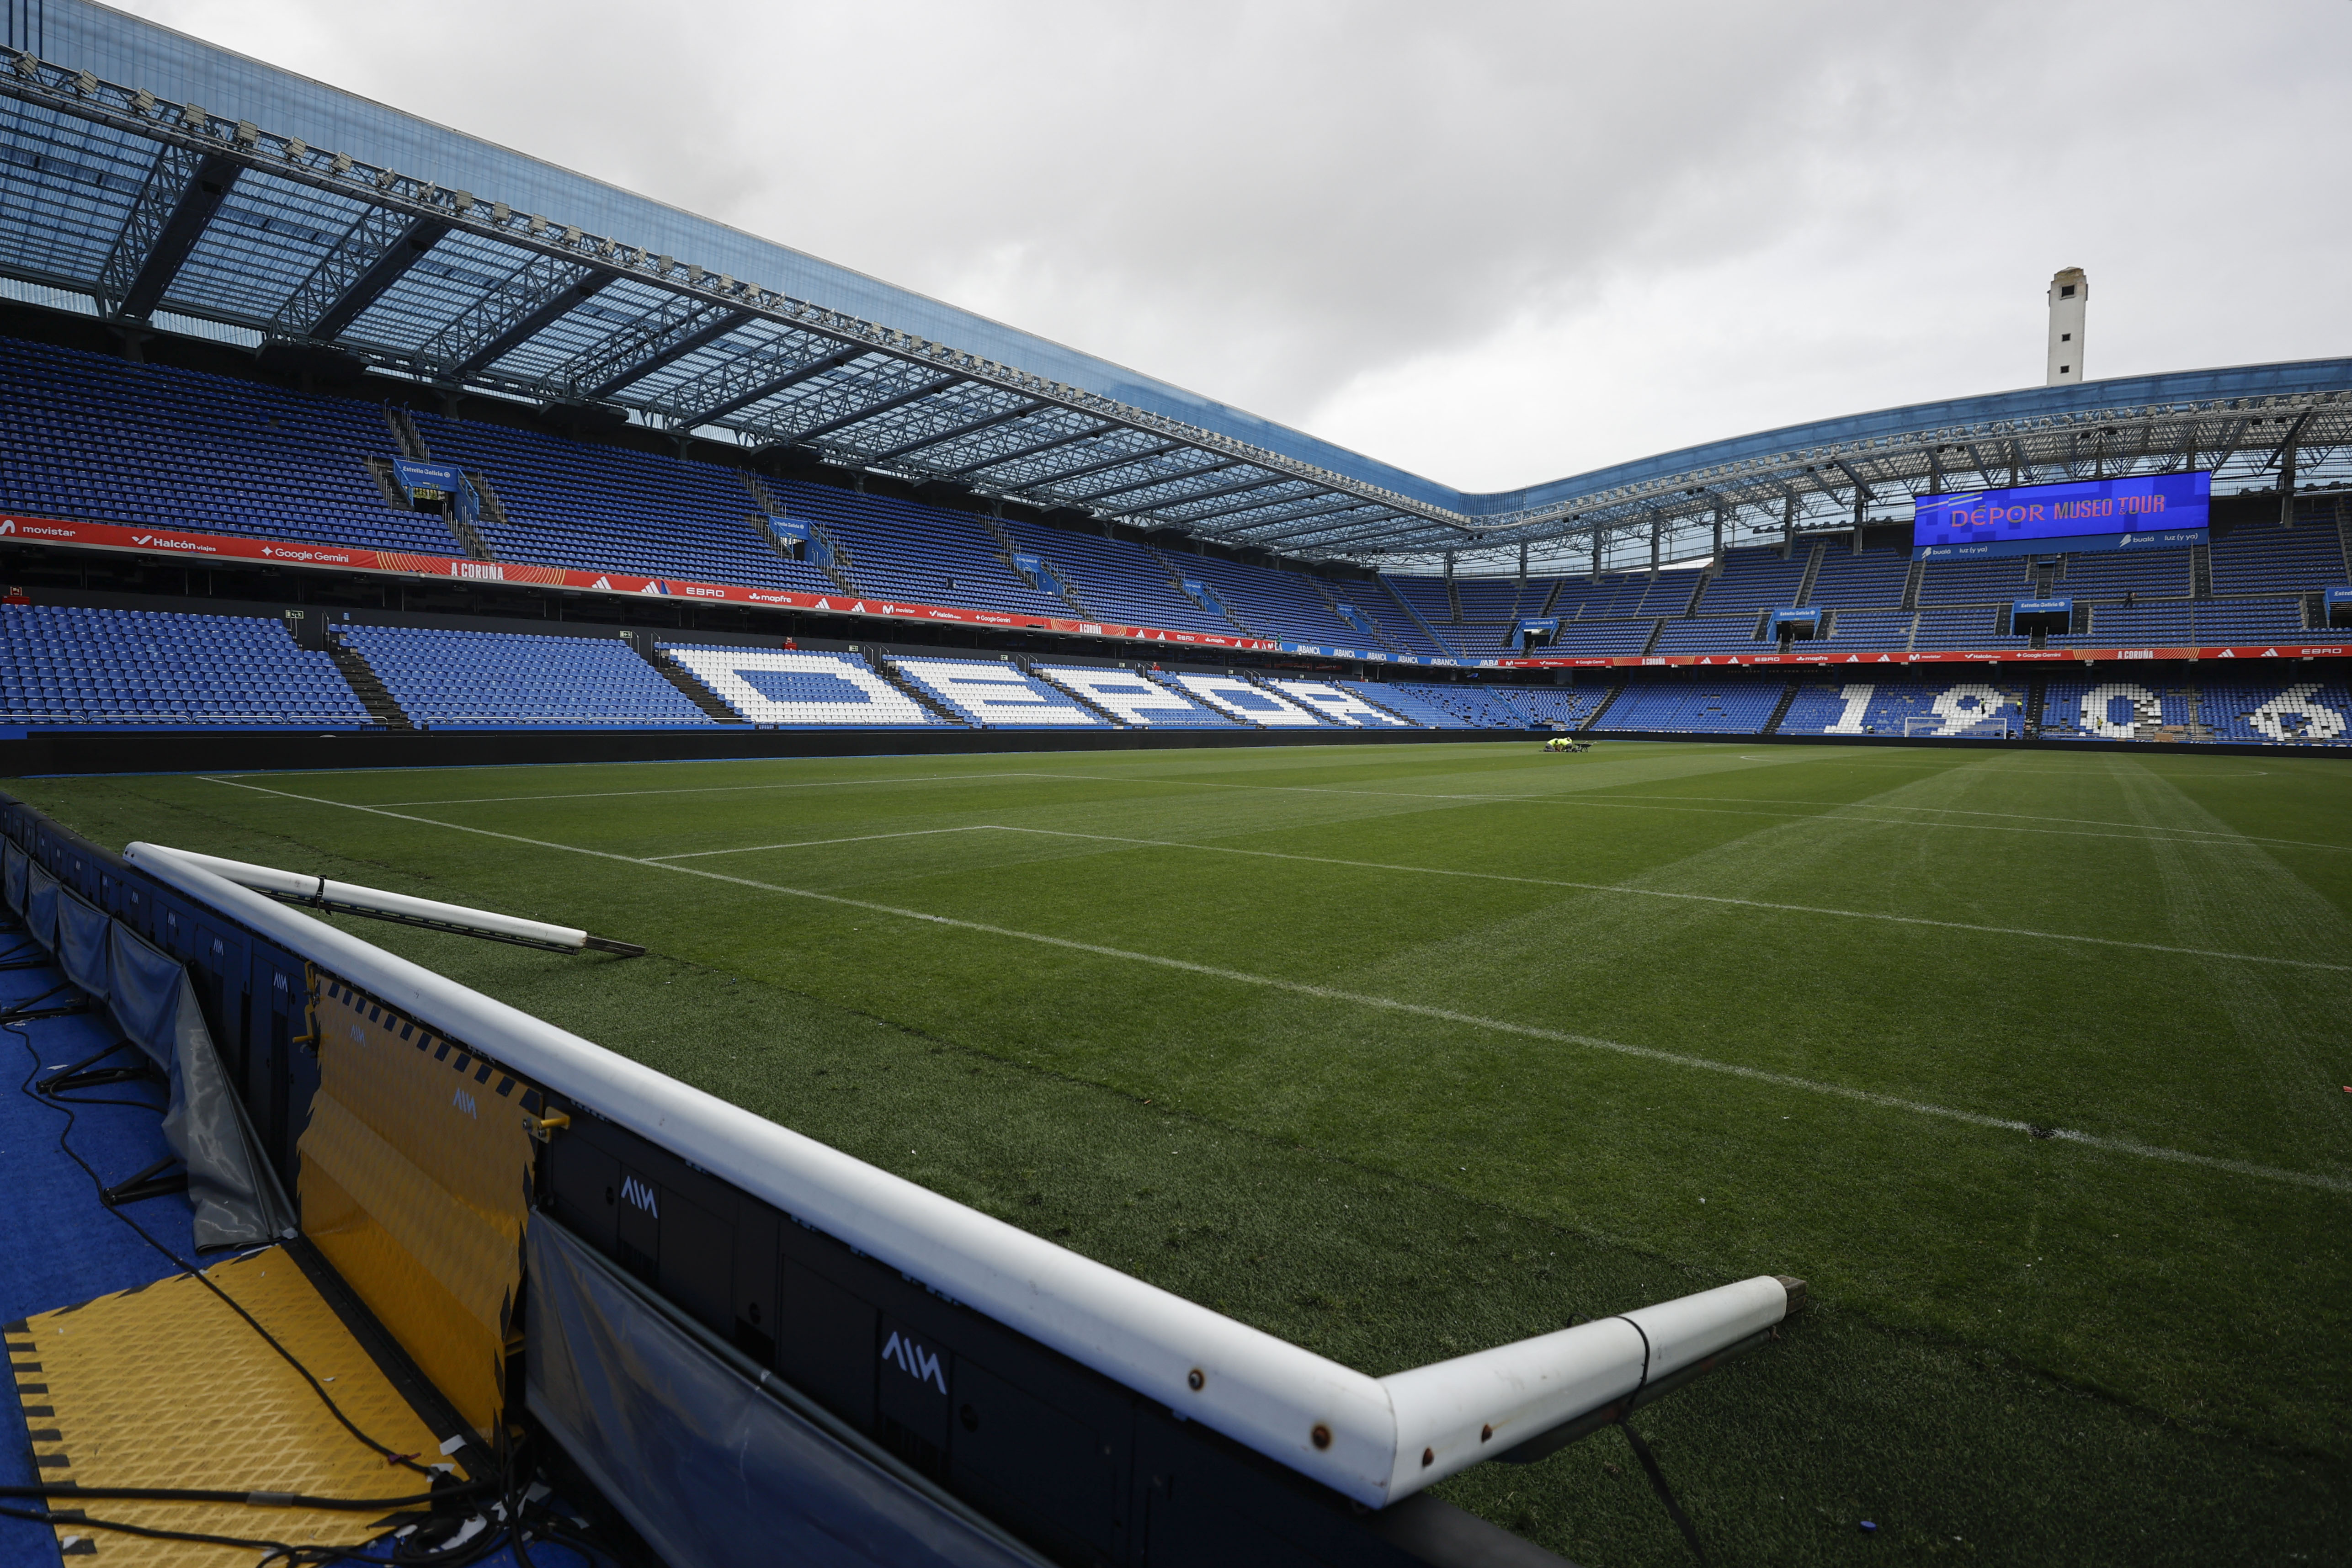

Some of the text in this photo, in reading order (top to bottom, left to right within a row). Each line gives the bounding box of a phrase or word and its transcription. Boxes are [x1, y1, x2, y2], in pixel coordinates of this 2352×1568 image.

[403, 466, 423, 474] Estrella
[2054, 498, 2113, 520] MUSEO
[2118, 494, 2165, 515] TOUR
[23, 526, 75, 537] movistar
[154, 538, 196, 549] Halcón
[2133, 535, 2154, 543] bualá
[275, 548, 349, 563] Google Gemini
[451, 562, 503, 580] A CORUÑA
[761, 594, 792, 604] mapfre
[981, 615, 996, 623] Google
[1080, 623, 1102, 634] A CORUÑA
[1299, 645, 1320, 655] ABANCA
[2124, 649, 2153, 659] CORUÑA
[1646, 657, 1665, 665] CORUÑA
[668, 648, 1410, 728] DEPOR
